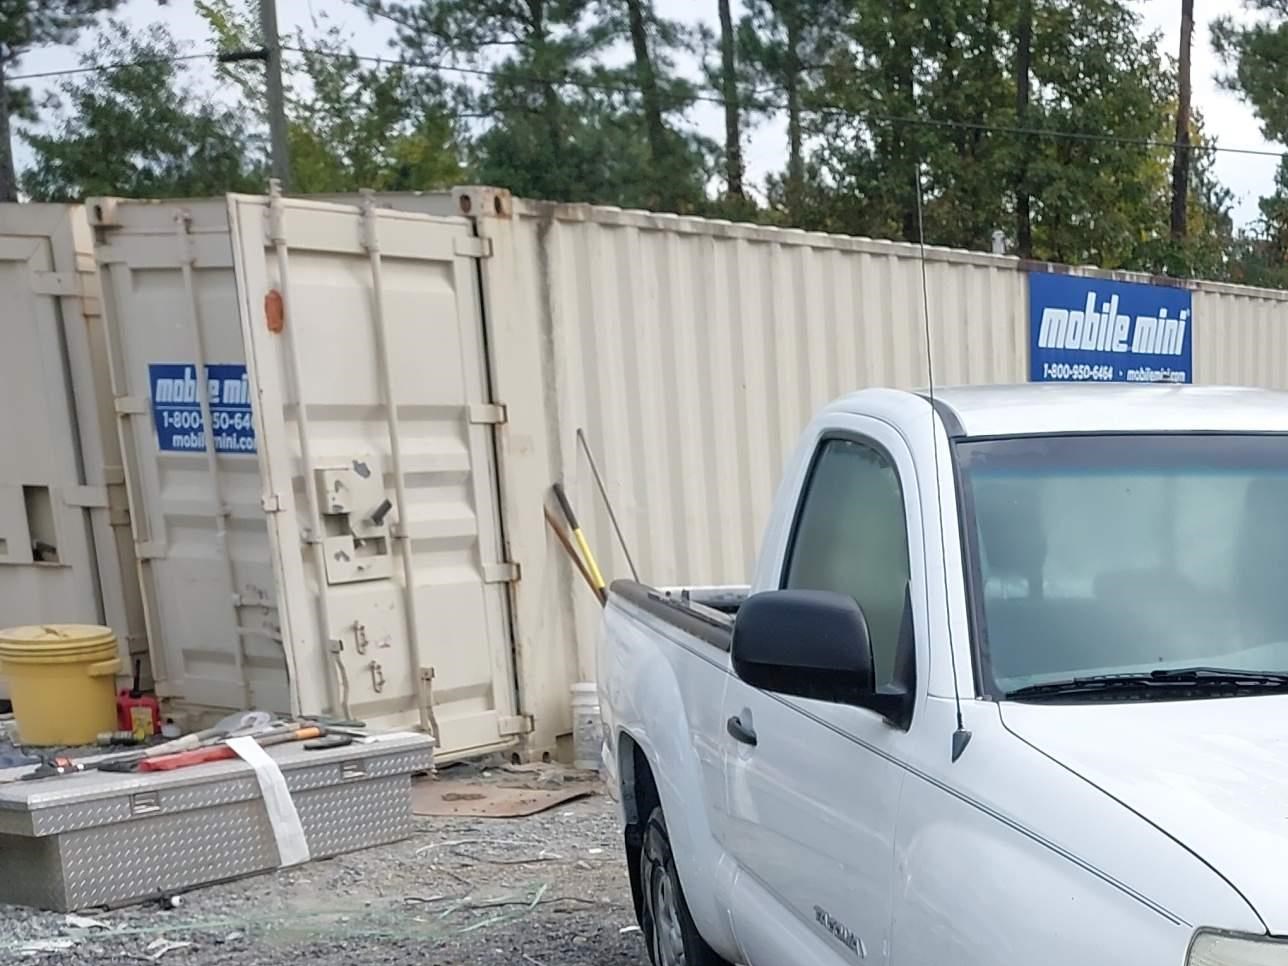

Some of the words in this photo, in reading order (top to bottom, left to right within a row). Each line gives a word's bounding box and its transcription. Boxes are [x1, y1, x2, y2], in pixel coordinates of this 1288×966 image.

[1038, 292, 1131, 353] mobile
[1132, 307, 1186, 355] mini
[1043, 362, 1113, 381] 1-800-950-6464
